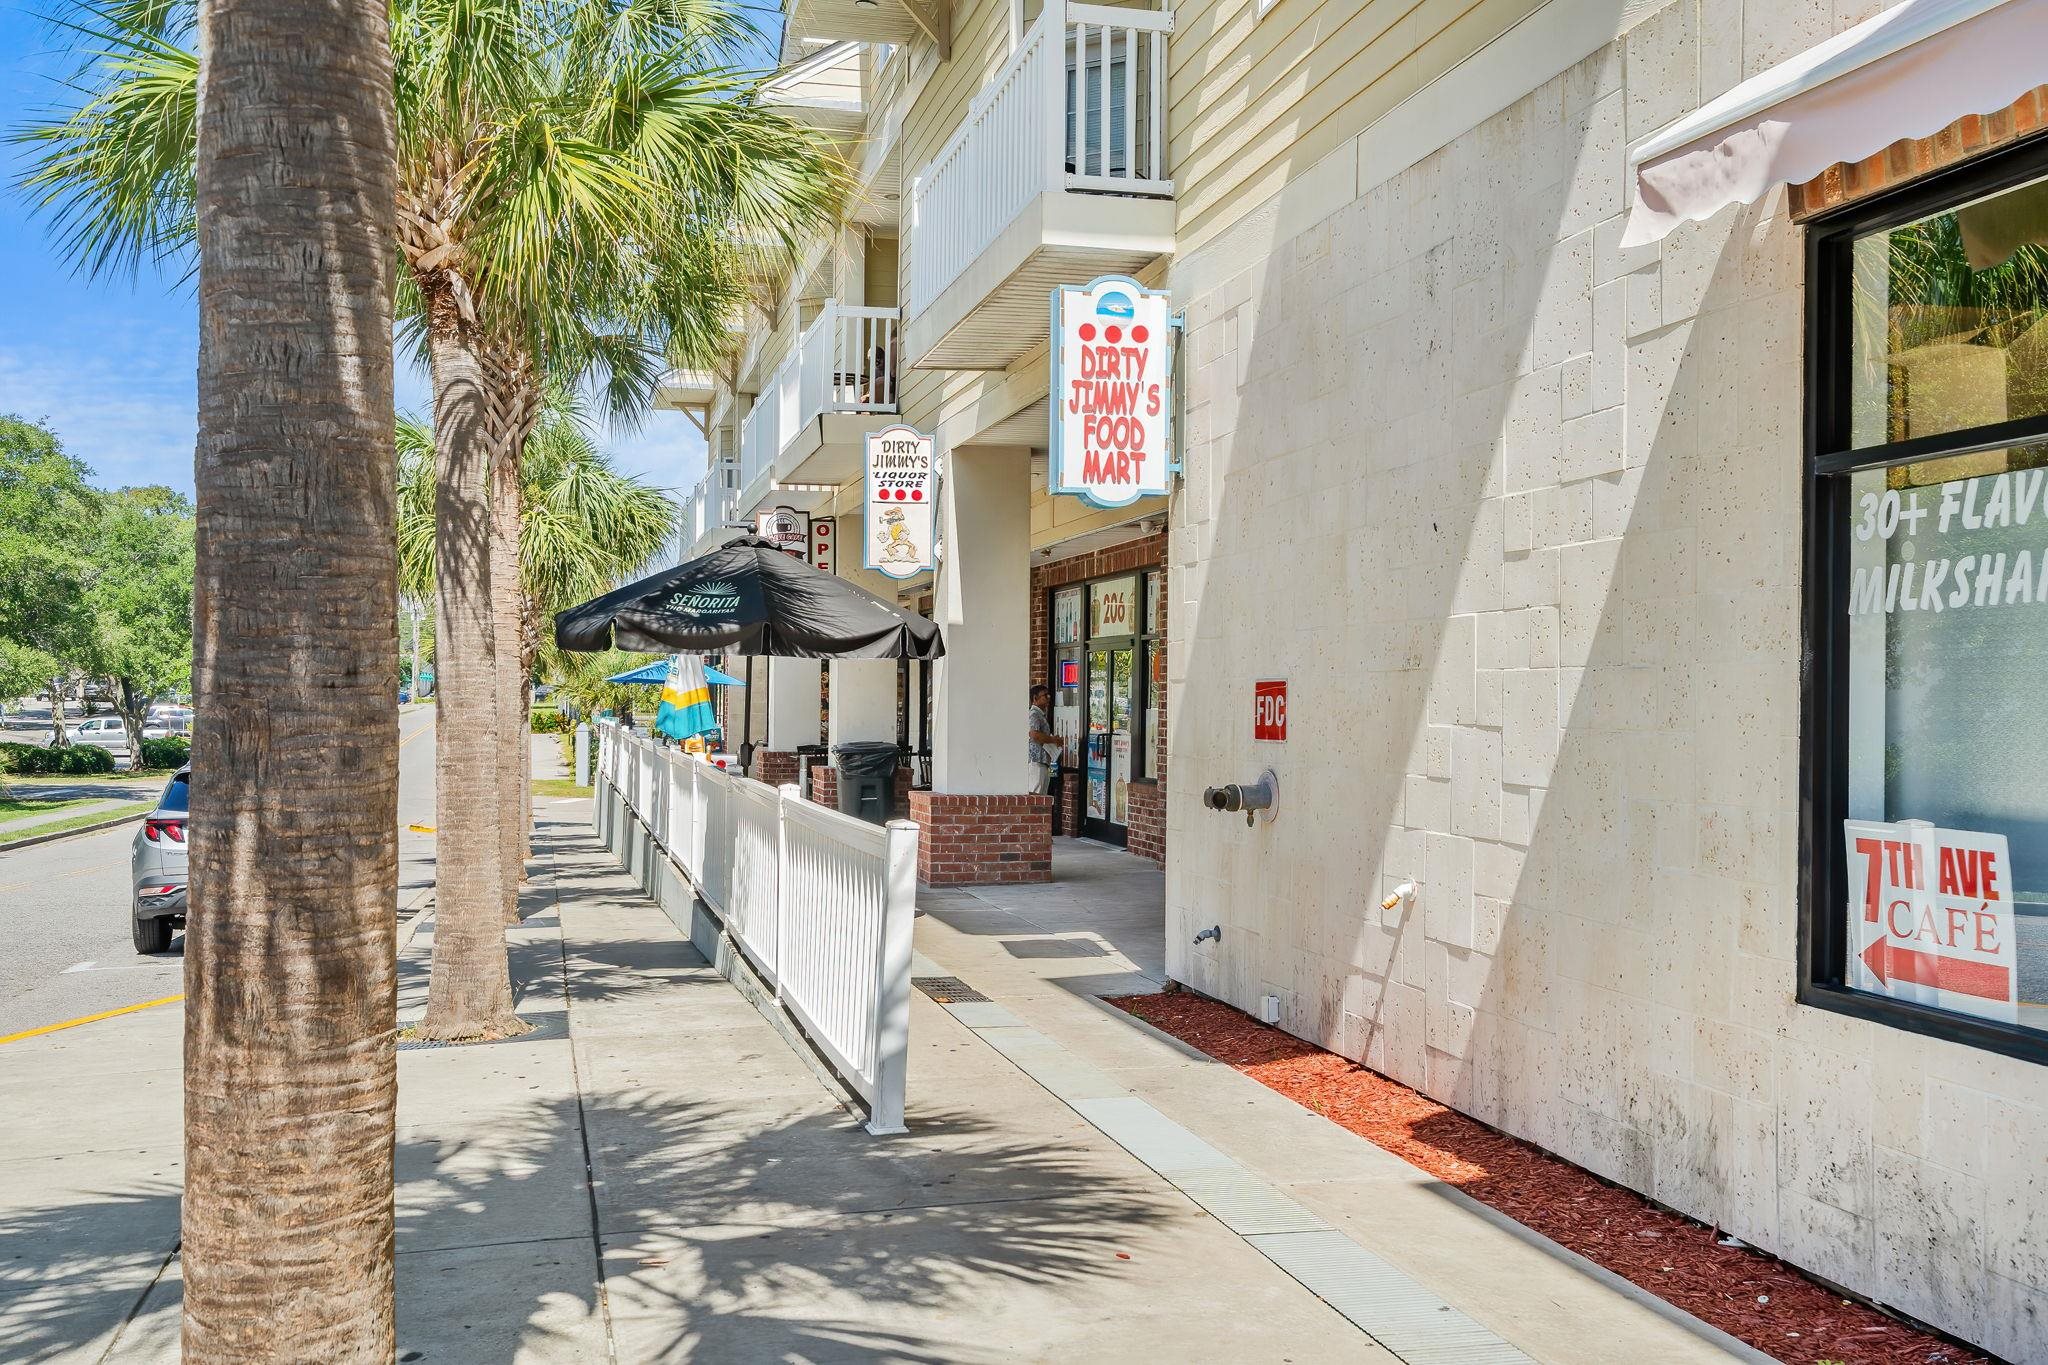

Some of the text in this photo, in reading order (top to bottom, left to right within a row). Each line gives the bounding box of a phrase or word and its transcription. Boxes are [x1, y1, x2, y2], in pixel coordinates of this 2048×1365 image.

[1081, 344, 1149, 380] DIRTY
[1069, 379, 1161, 417] JIMMY'S
[882, 440, 920, 454] DIRTY
[1083, 415, 1145, 451] FOOD
[872, 454, 928, 469] JIMMY'S
[873, 471, 928, 480] LIQUOR
[1082, 450, 1146, 485] MART
[878, 480, 923, 488] STORE
[1855, 489, 1928, 542] 30+
[1103, 592, 1125, 625] 206
[1256, 694, 1285, 727] FDC
[1856, 837, 2000, 924] 7TH AVE
[1887, 900, 2001, 954] CAFÉ
